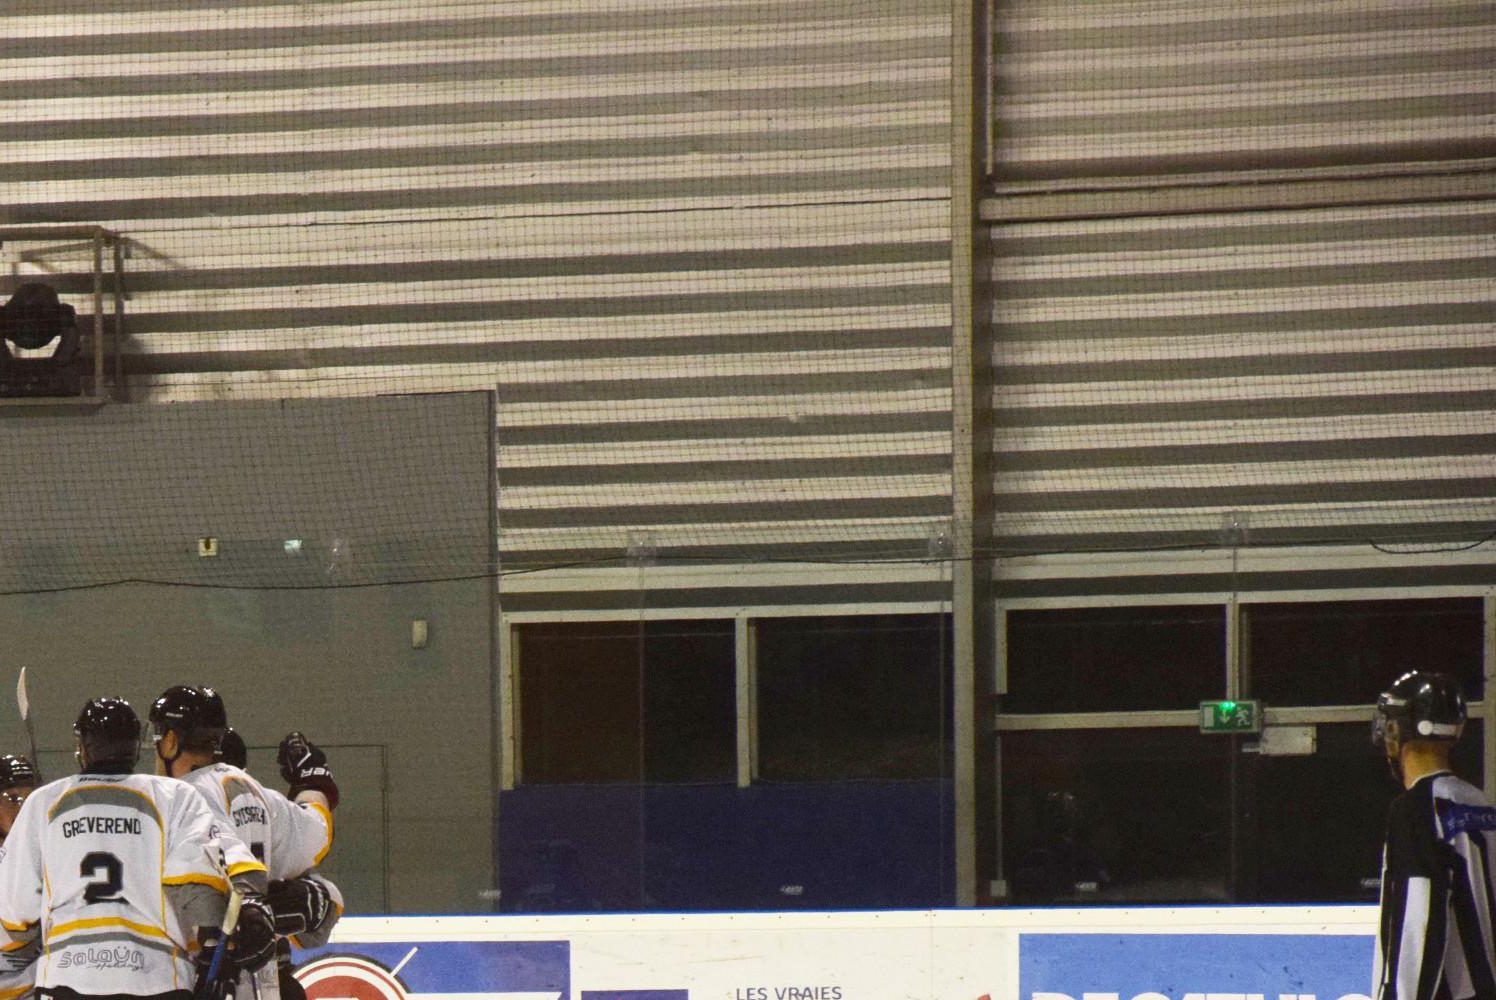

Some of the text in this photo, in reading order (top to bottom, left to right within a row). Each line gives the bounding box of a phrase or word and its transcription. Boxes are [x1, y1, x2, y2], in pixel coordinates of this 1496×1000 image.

[62, 816, 142, 839] GREVEREND
[79, 850, 131, 906] 2
[773, 986, 843, 1000] VRAIES
